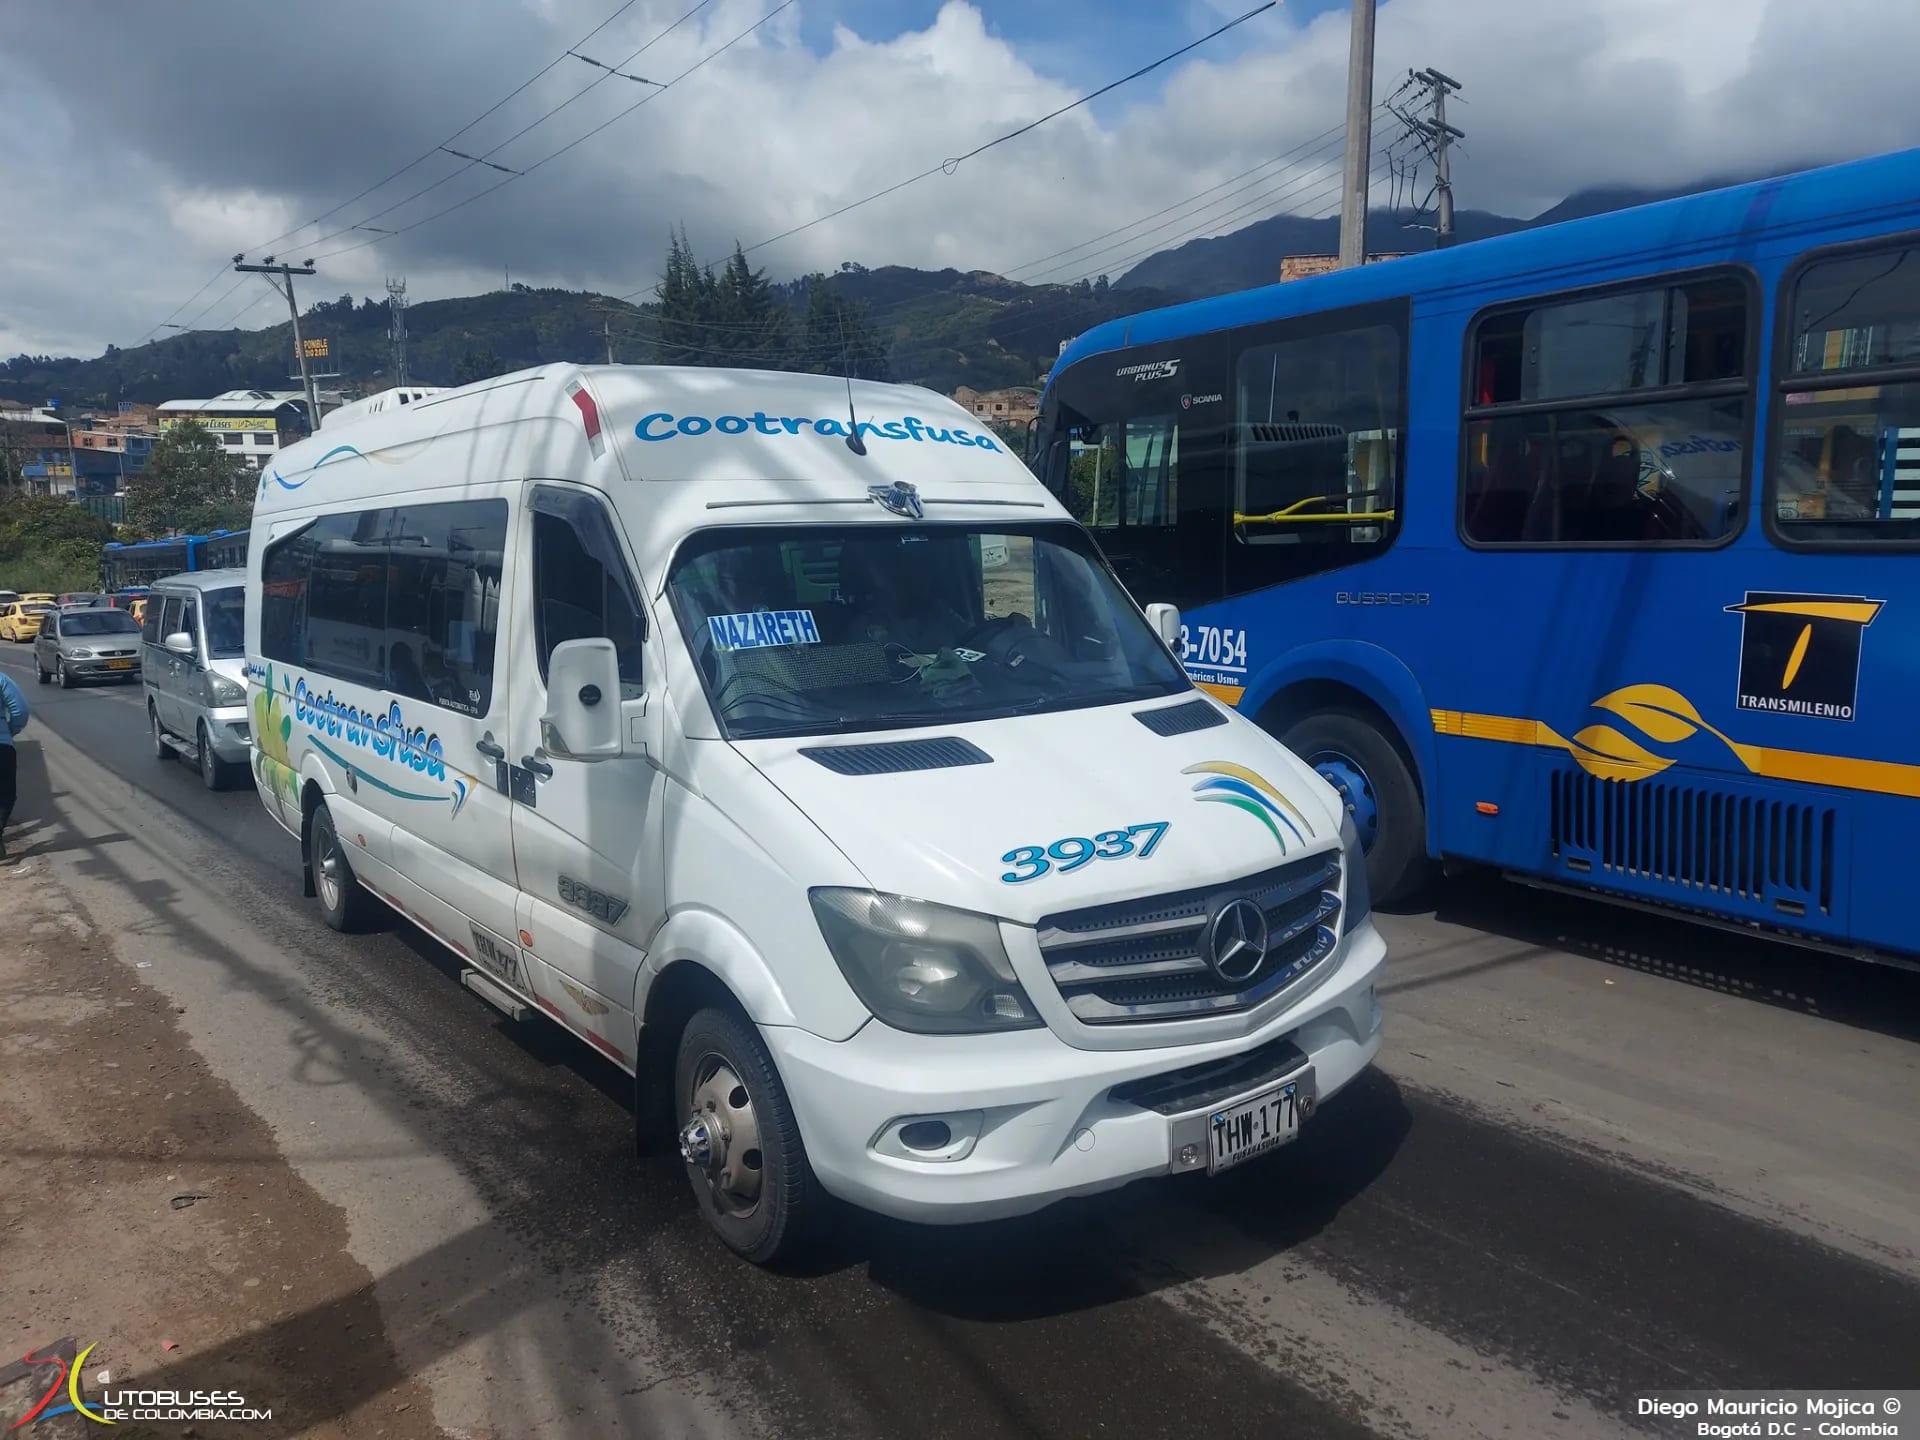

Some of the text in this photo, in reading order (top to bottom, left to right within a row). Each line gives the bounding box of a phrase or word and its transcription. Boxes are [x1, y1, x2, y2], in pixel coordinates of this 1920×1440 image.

[1192, 394, 1222, 405] SCANIA
[635, 411, 1003, 455] Cootransfusa
[1336, 591, 1430, 605] BUSSCAR
[711, 611, 819, 648] NAZARETH
[1180, 624, 1247, 666] 3-7054
[1217, 673, 1239, 685] Usme
[1740, 694, 1852, 719] TRANSMILENIO
[294, 677, 446, 782] Cootransfusa
[1001, 821, 1171, 884] 3937
